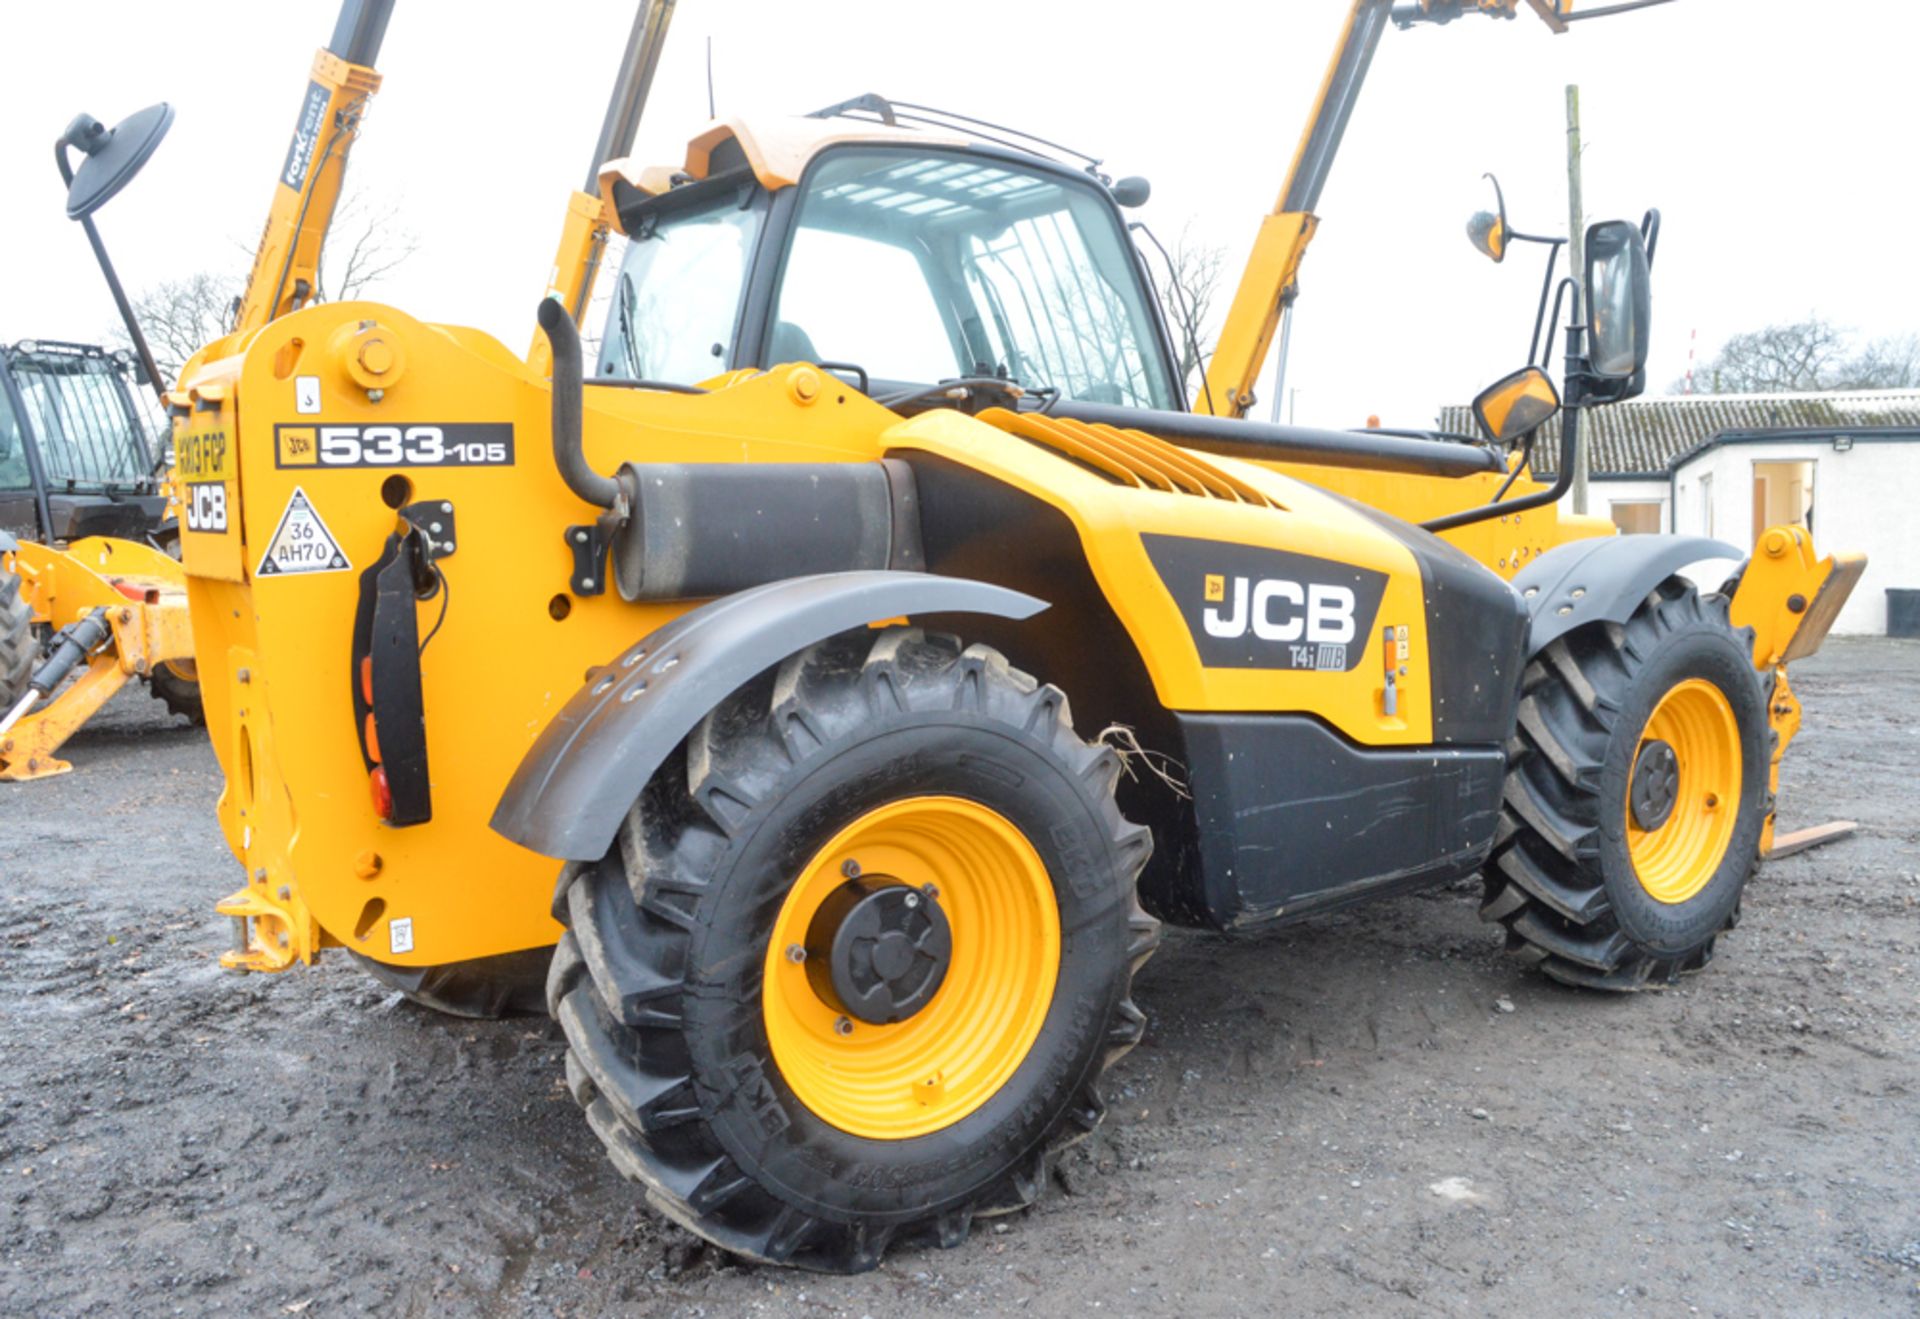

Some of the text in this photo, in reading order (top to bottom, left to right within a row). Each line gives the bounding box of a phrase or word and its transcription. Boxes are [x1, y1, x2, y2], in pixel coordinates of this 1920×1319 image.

[320, 426, 507, 464] 533-105
[187, 485, 227, 530] JCB
[290, 522, 314, 540] 36
[279, 543, 328, 562] AH70
[1203, 576, 1356, 644] JCB
[1288, 645, 1316, 669] T4i
